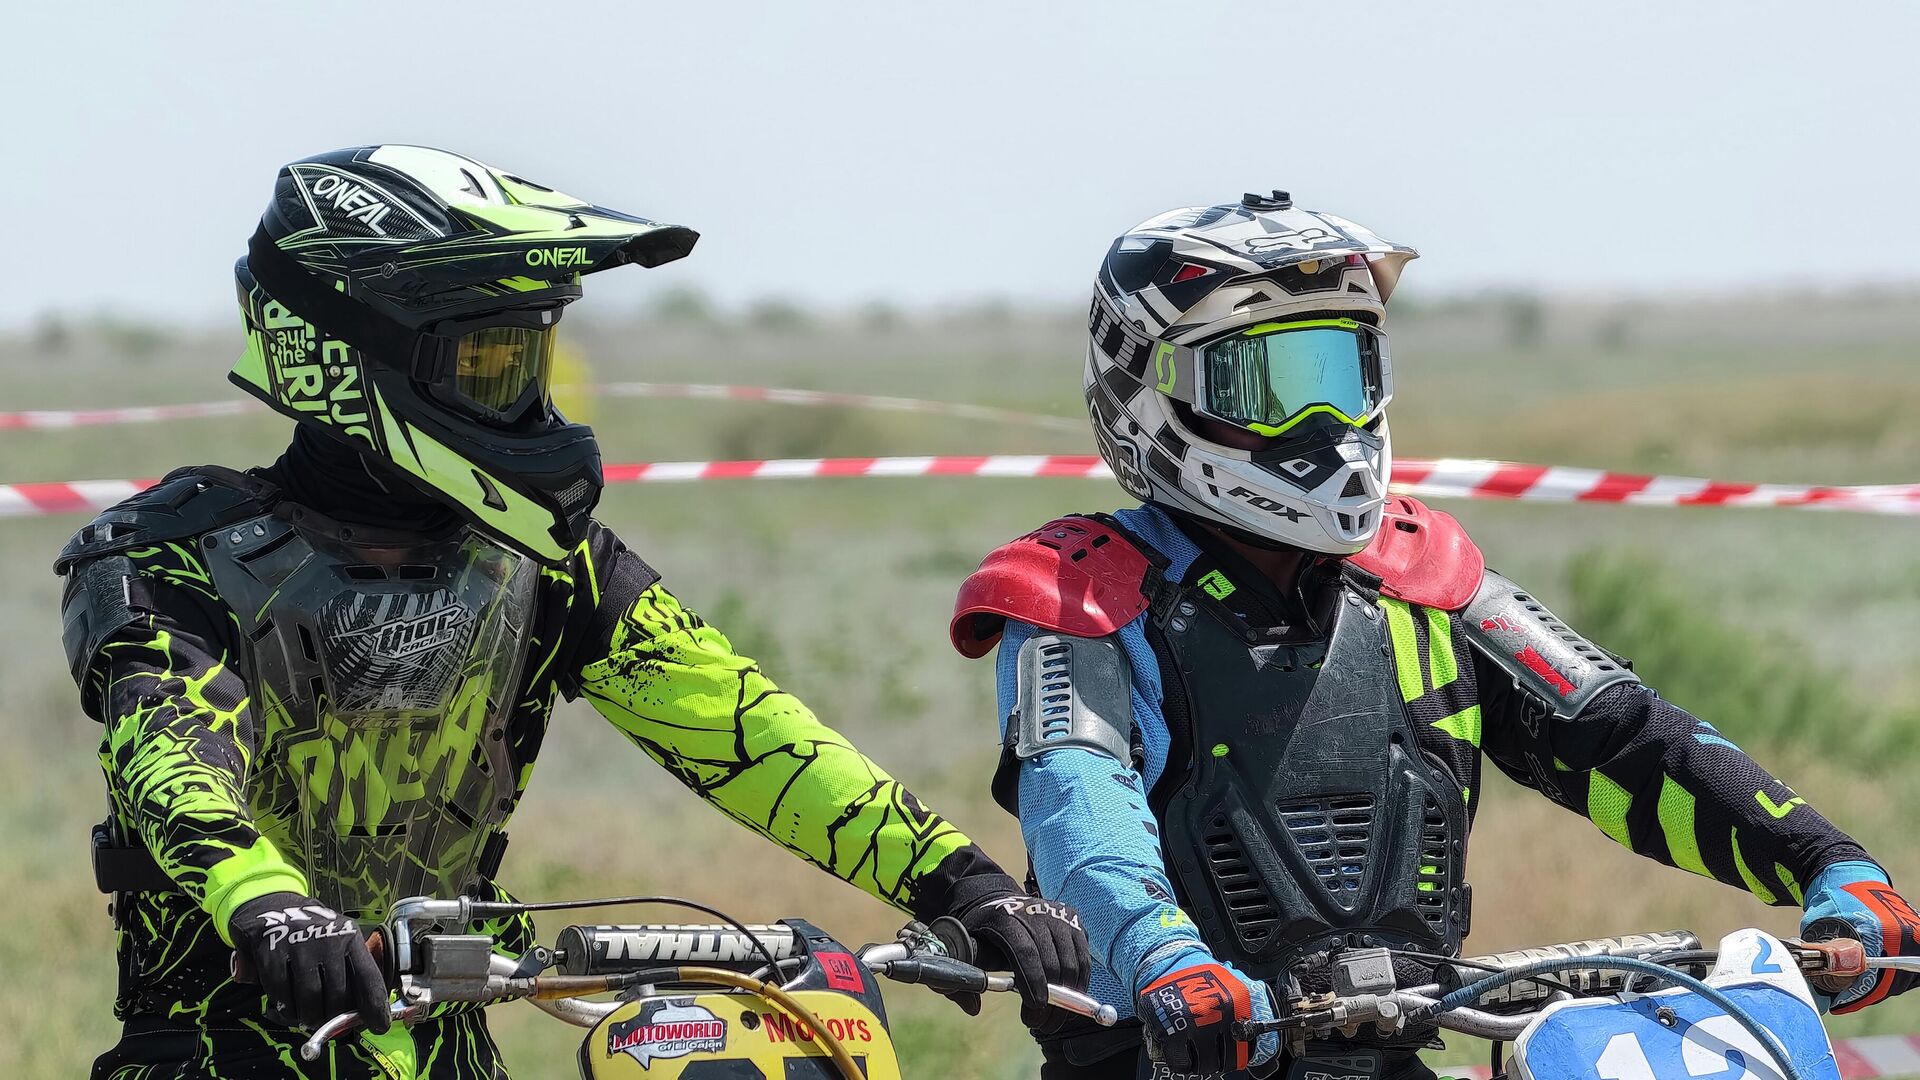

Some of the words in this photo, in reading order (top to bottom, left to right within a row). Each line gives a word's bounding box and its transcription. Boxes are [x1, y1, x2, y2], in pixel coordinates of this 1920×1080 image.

[1226, 486, 1313, 523] FOX
[995, 900, 1082, 931] Parts
[262, 919, 357, 951] Parts
[828, 959, 852, 977] GM
[1750, 935, 1783, 975] 2
[1158, 985, 1188, 1031] GoPro
[1175, 976, 1230, 1028] KTM
[762, 1012, 872, 1043] Moors
[659, 1042, 673, 1052] of
